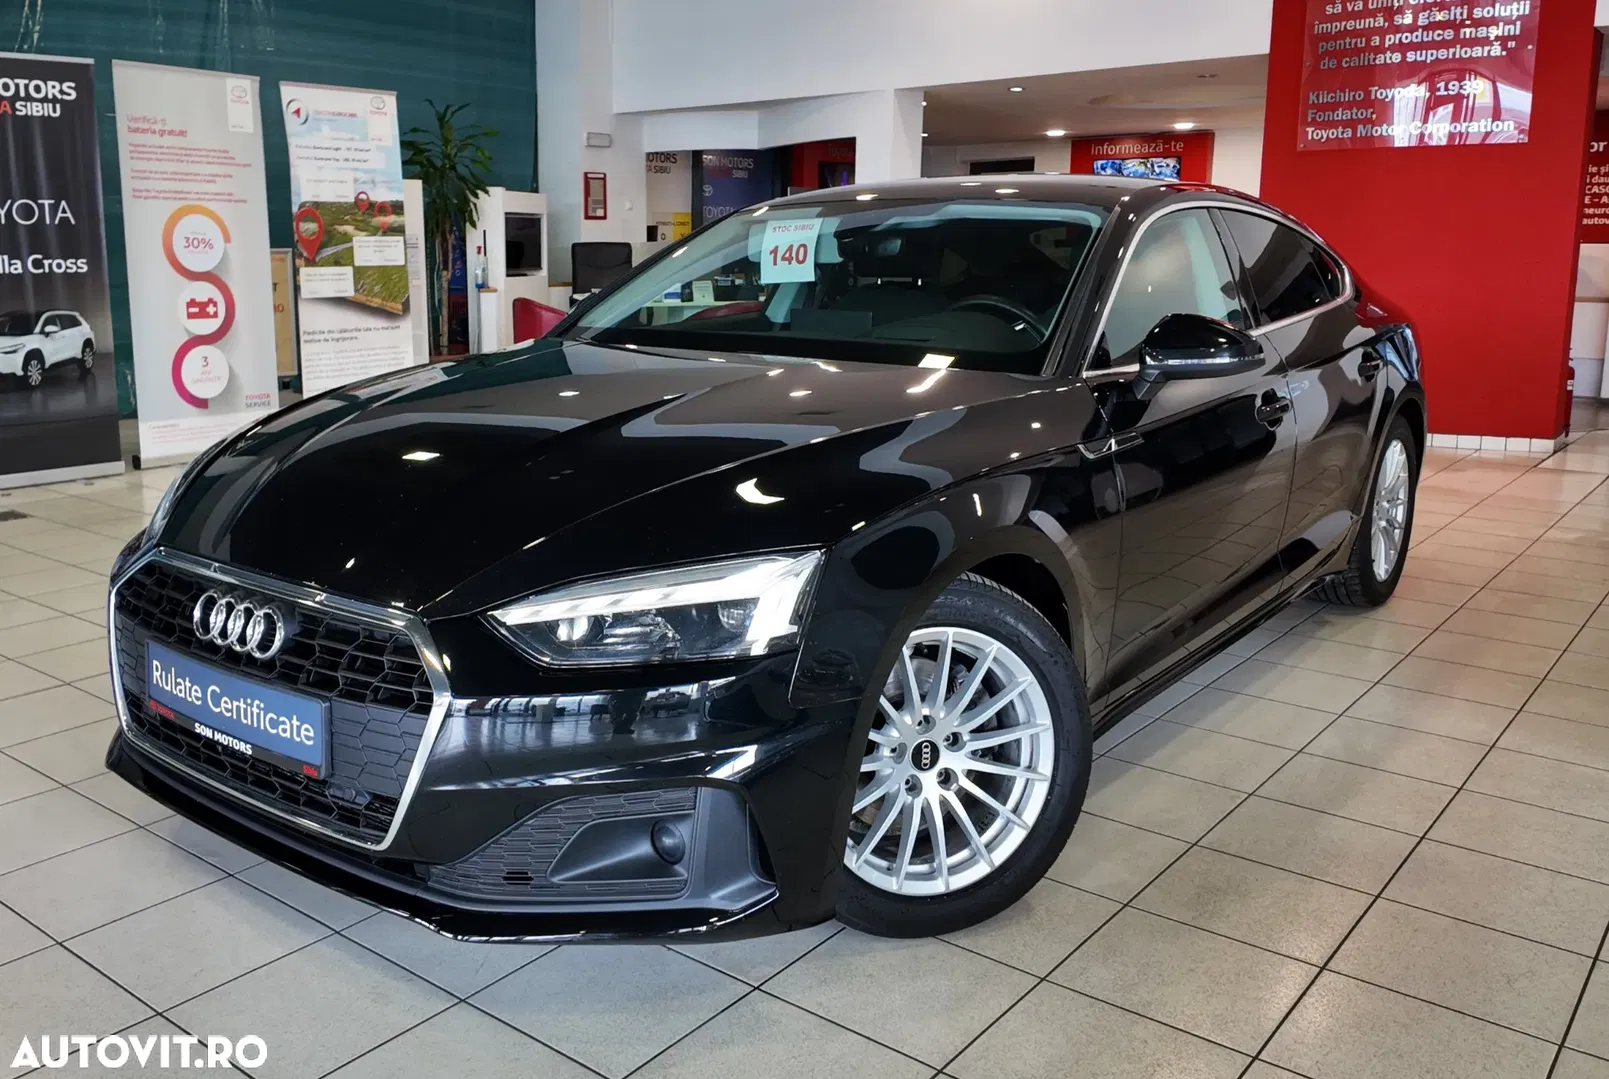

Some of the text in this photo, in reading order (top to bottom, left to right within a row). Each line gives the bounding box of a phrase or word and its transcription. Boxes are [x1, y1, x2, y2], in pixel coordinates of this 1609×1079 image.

[1314, 1, 1530, 34] împreună, să găsiți soluții
[1319, 37, 1366, 54] pentru
[1371, 35, 1380, 46] a
[1385, 28, 1454, 48] produce
[1320, 56, 1337, 69] de
[1342, 50, 1401, 67] calitate
[0, 77, 77, 100] OTORS
[1309, 89, 1364, 104] Kiichiro
[1436, 79, 1484, 96] 1939
[15, 101, 61, 117] SIBIU
[1308, 107, 1376, 122] Fondator,
[1306, 126, 1352, 142] Toyota
[1409, 117, 1515, 136] Corporation
[1091, 140, 1184, 155] Informează-te
[702, 155, 754, 168] SON MOTORS
[772, 223, 815, 233] STOC SIBIU
[183, 236, 214, 250] 30%
[27, 254, 88, 274] Cross
[769, 243, 808, 266] 140
[202, 356, 209, 368] 3
[152, 660, 315, 745] Rulate Certificate
[194, 722, 253, 755] SON MOTORS
